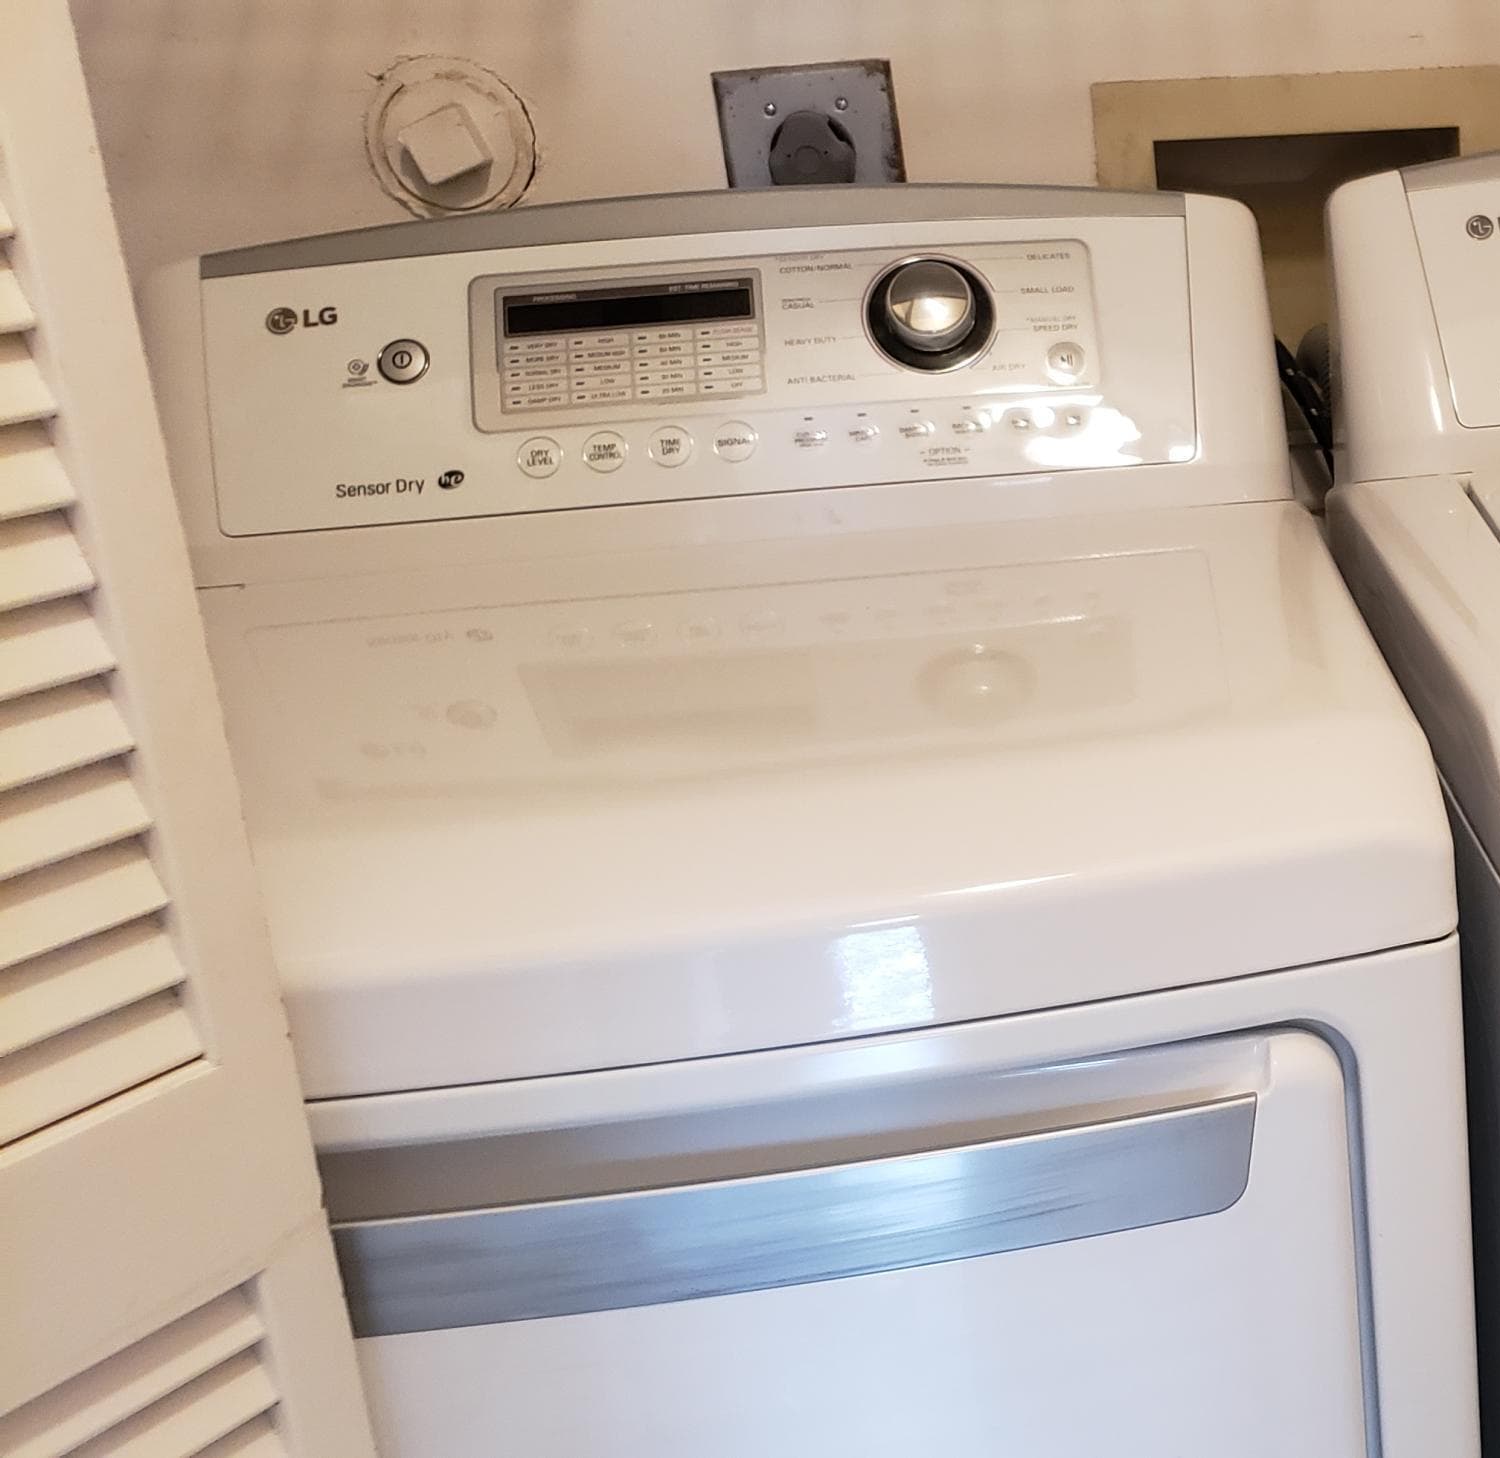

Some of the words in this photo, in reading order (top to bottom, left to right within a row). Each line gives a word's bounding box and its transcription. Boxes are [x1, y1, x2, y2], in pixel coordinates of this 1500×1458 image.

[1020, 287, 1049, 295] SMALL
[1051, 285, 1074, 293] LOAD
[303, 306, 338, 328] LG
[1033, 324, 1060, 332] SPEED
[1062, 323, 1078, 331] DRY
[660, 438, 681, 447] TIME
[530, 449, 549, 458] DRY
[662, 446, 680, 456] DRY
[527, 456, 554, 467] LEVEL
[589, 451, 622, 462] CONTROL
[336, 481, 392, 498] Sensor
[396, 478, 425, 495] Dry
